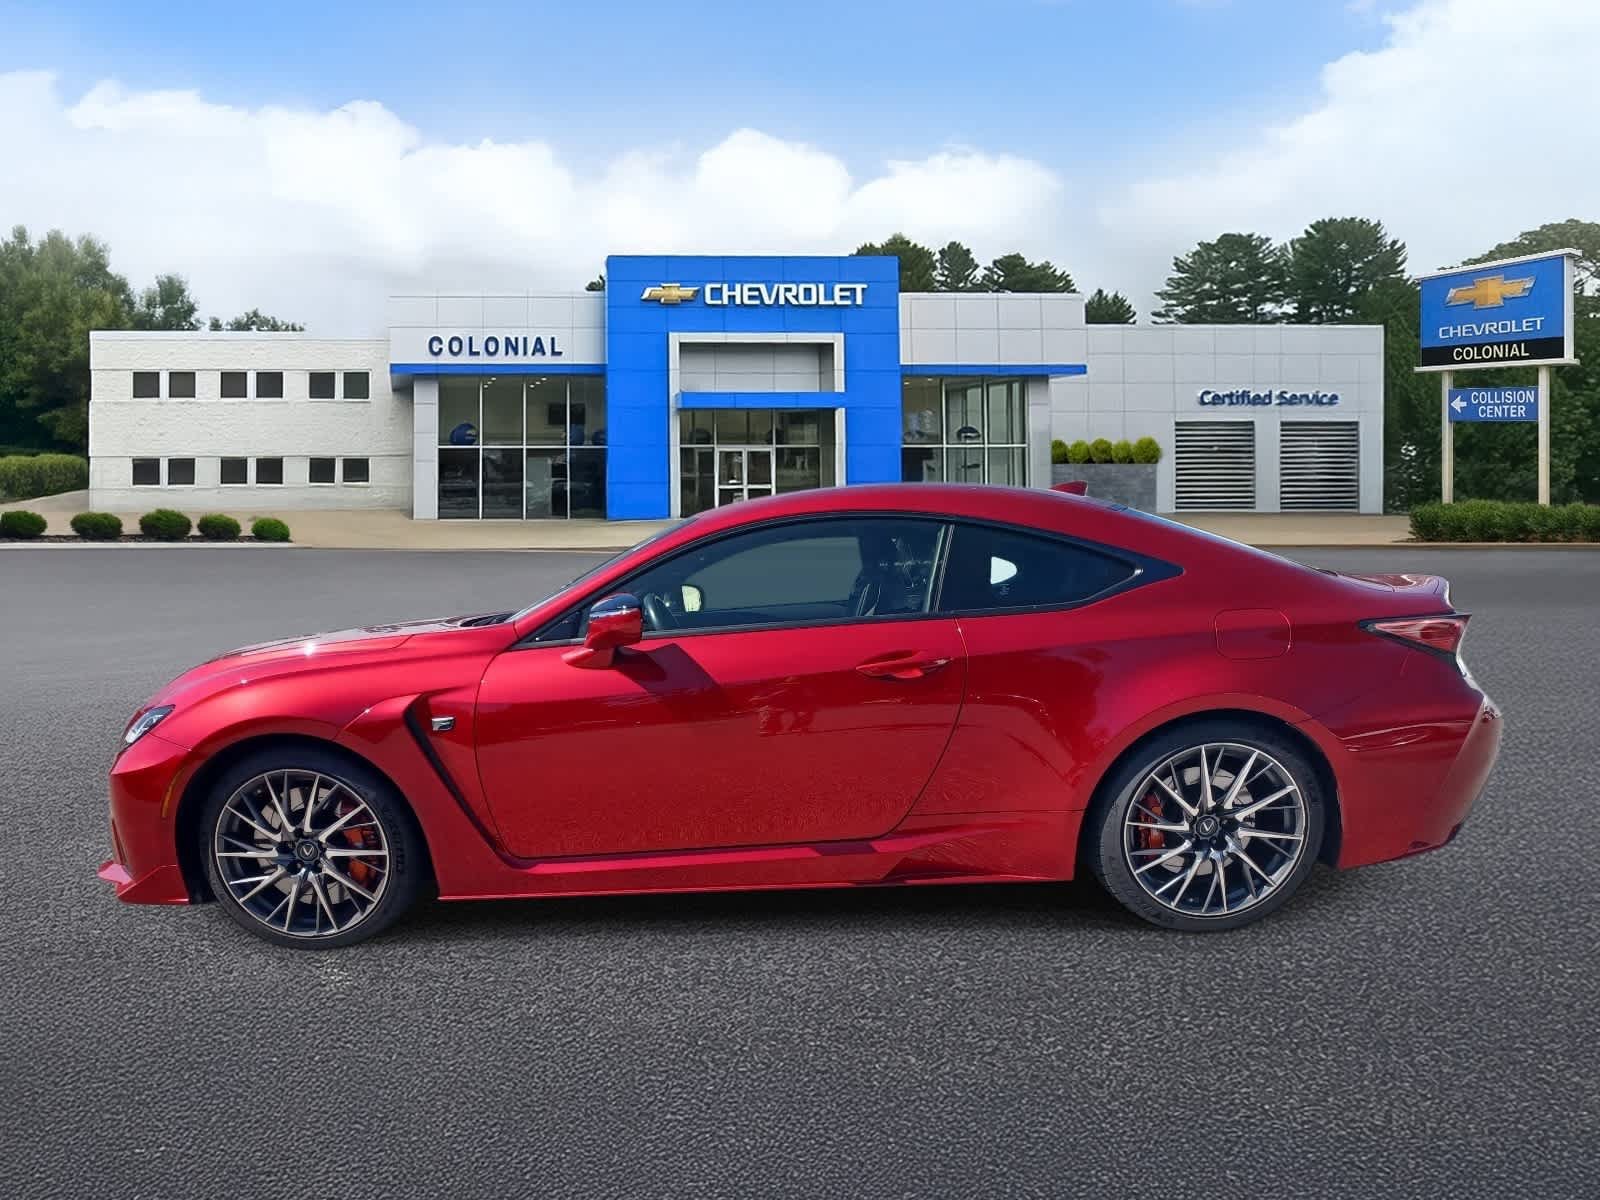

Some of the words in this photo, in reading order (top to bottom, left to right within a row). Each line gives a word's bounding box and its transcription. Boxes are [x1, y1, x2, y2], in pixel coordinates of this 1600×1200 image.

[704, 283, 868, 306] CHEVROLET
[1439, 317, 1544, 338] CHEVROLET
[428, 336, 564, 357] COLONIAL
[1453, 343, 1530, 361] COLONIAL
[1199, 389, 1273, 406] Certified
[1277, 389, 1339, 406] Service
[1471, 390, 1535, 404] COLLISION
[1478, 405, 1526, 418] CENTER
